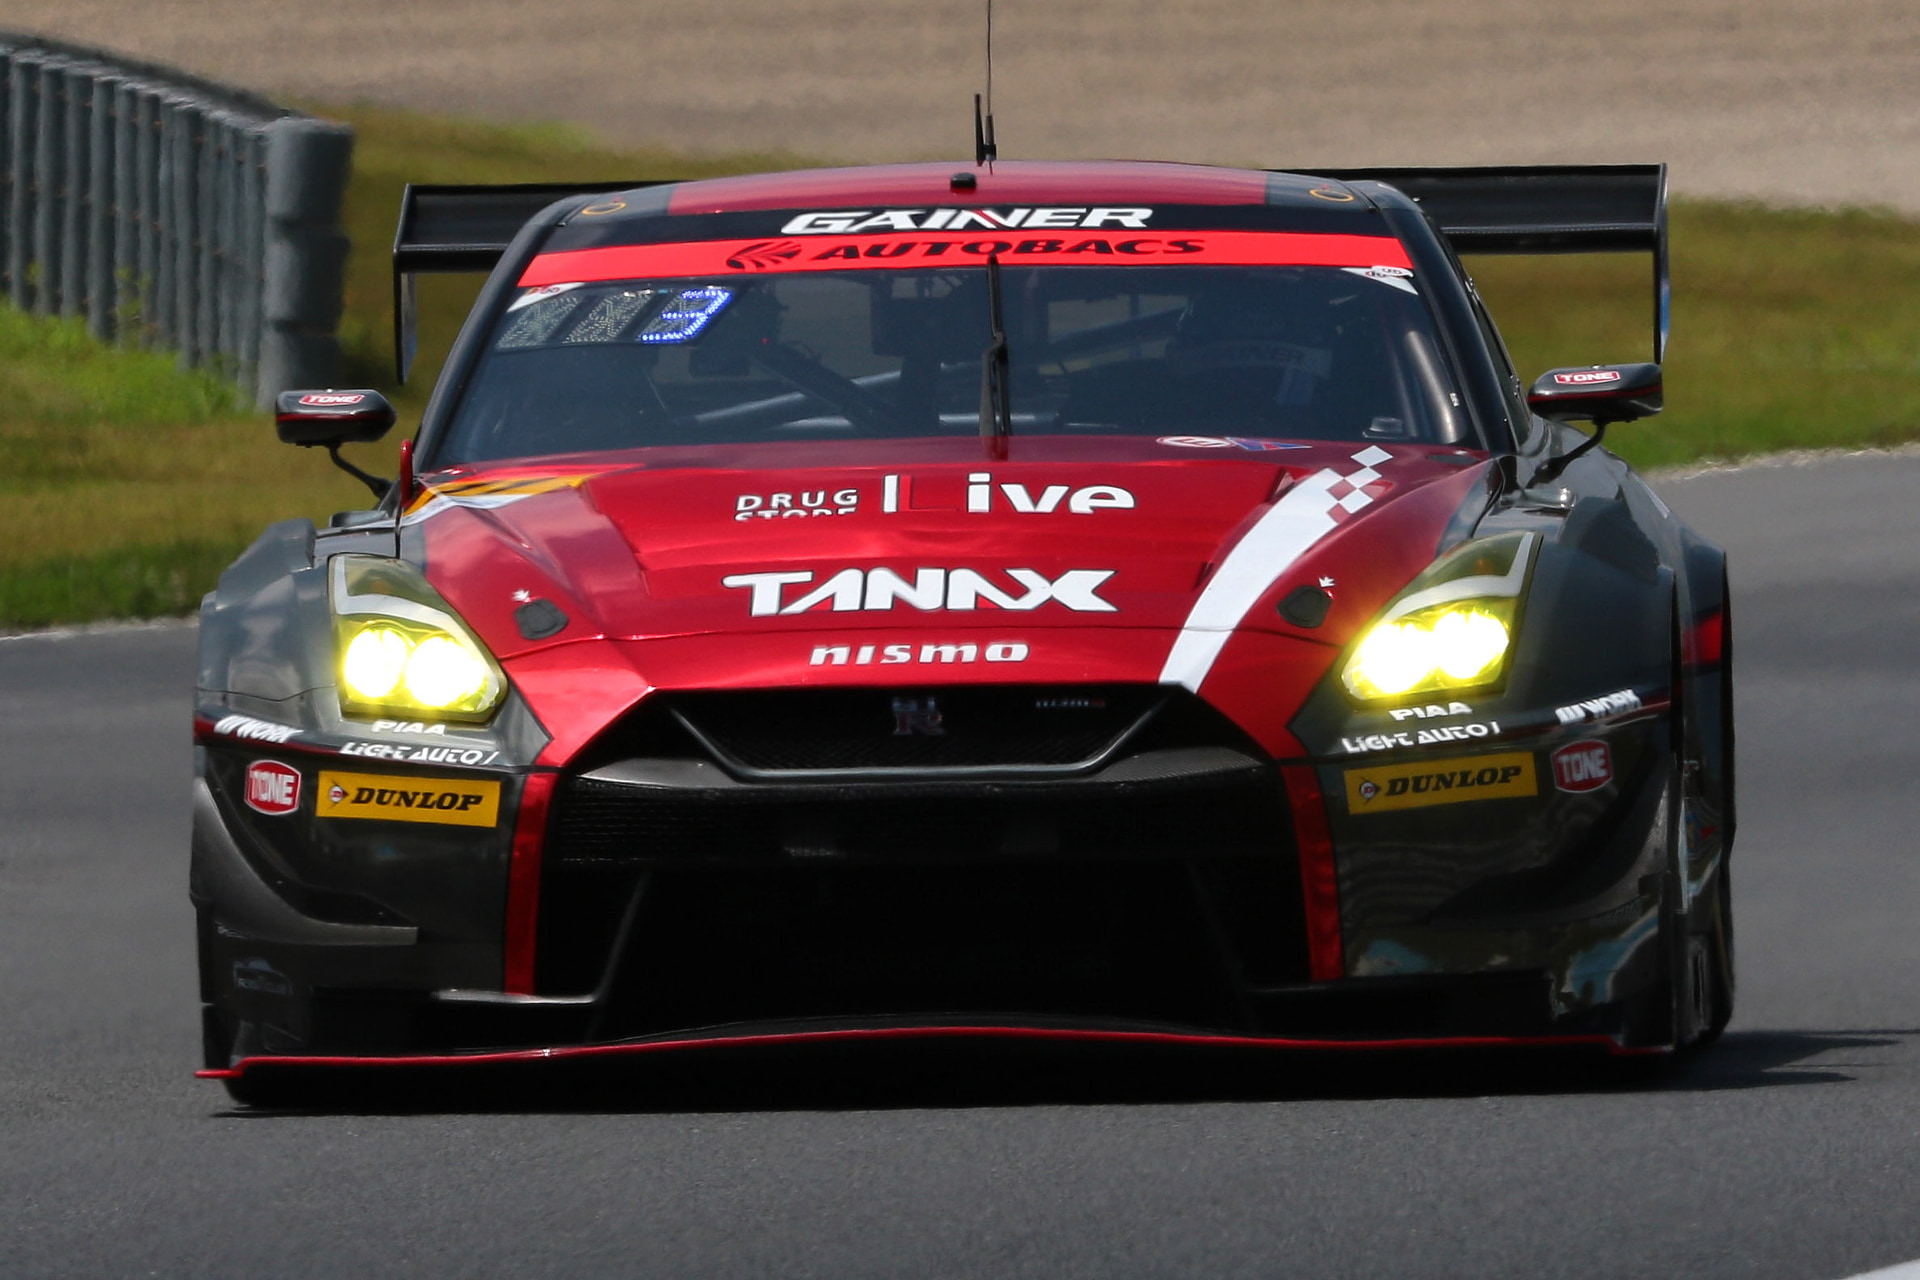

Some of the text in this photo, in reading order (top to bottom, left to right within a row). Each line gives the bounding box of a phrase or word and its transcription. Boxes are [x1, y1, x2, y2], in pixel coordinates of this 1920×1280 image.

[781, 208, 1153, 234] GAINER
[809, 238, 1206, 260] AUTOBACS
[641, 289, 732, 344] 3
[1559, 371, 1614, 382] TONE
[309, 394, 358, 404] TONE
[735, 488, 859, 512] DRUG
[721, 566, 1120, 618] TANAX
[808, 642, 1031, 667] nismo
[1388, 701, 1474, 721] PIAA
[371, 718, 447, 737] PIAA
[1557, 747, 1609, 784] TONE
[249, 769, 296, 806] TONE
[1385, 765, 1523, 797] DUNLOP
[351, 786, 484, 812] DUNLOP
